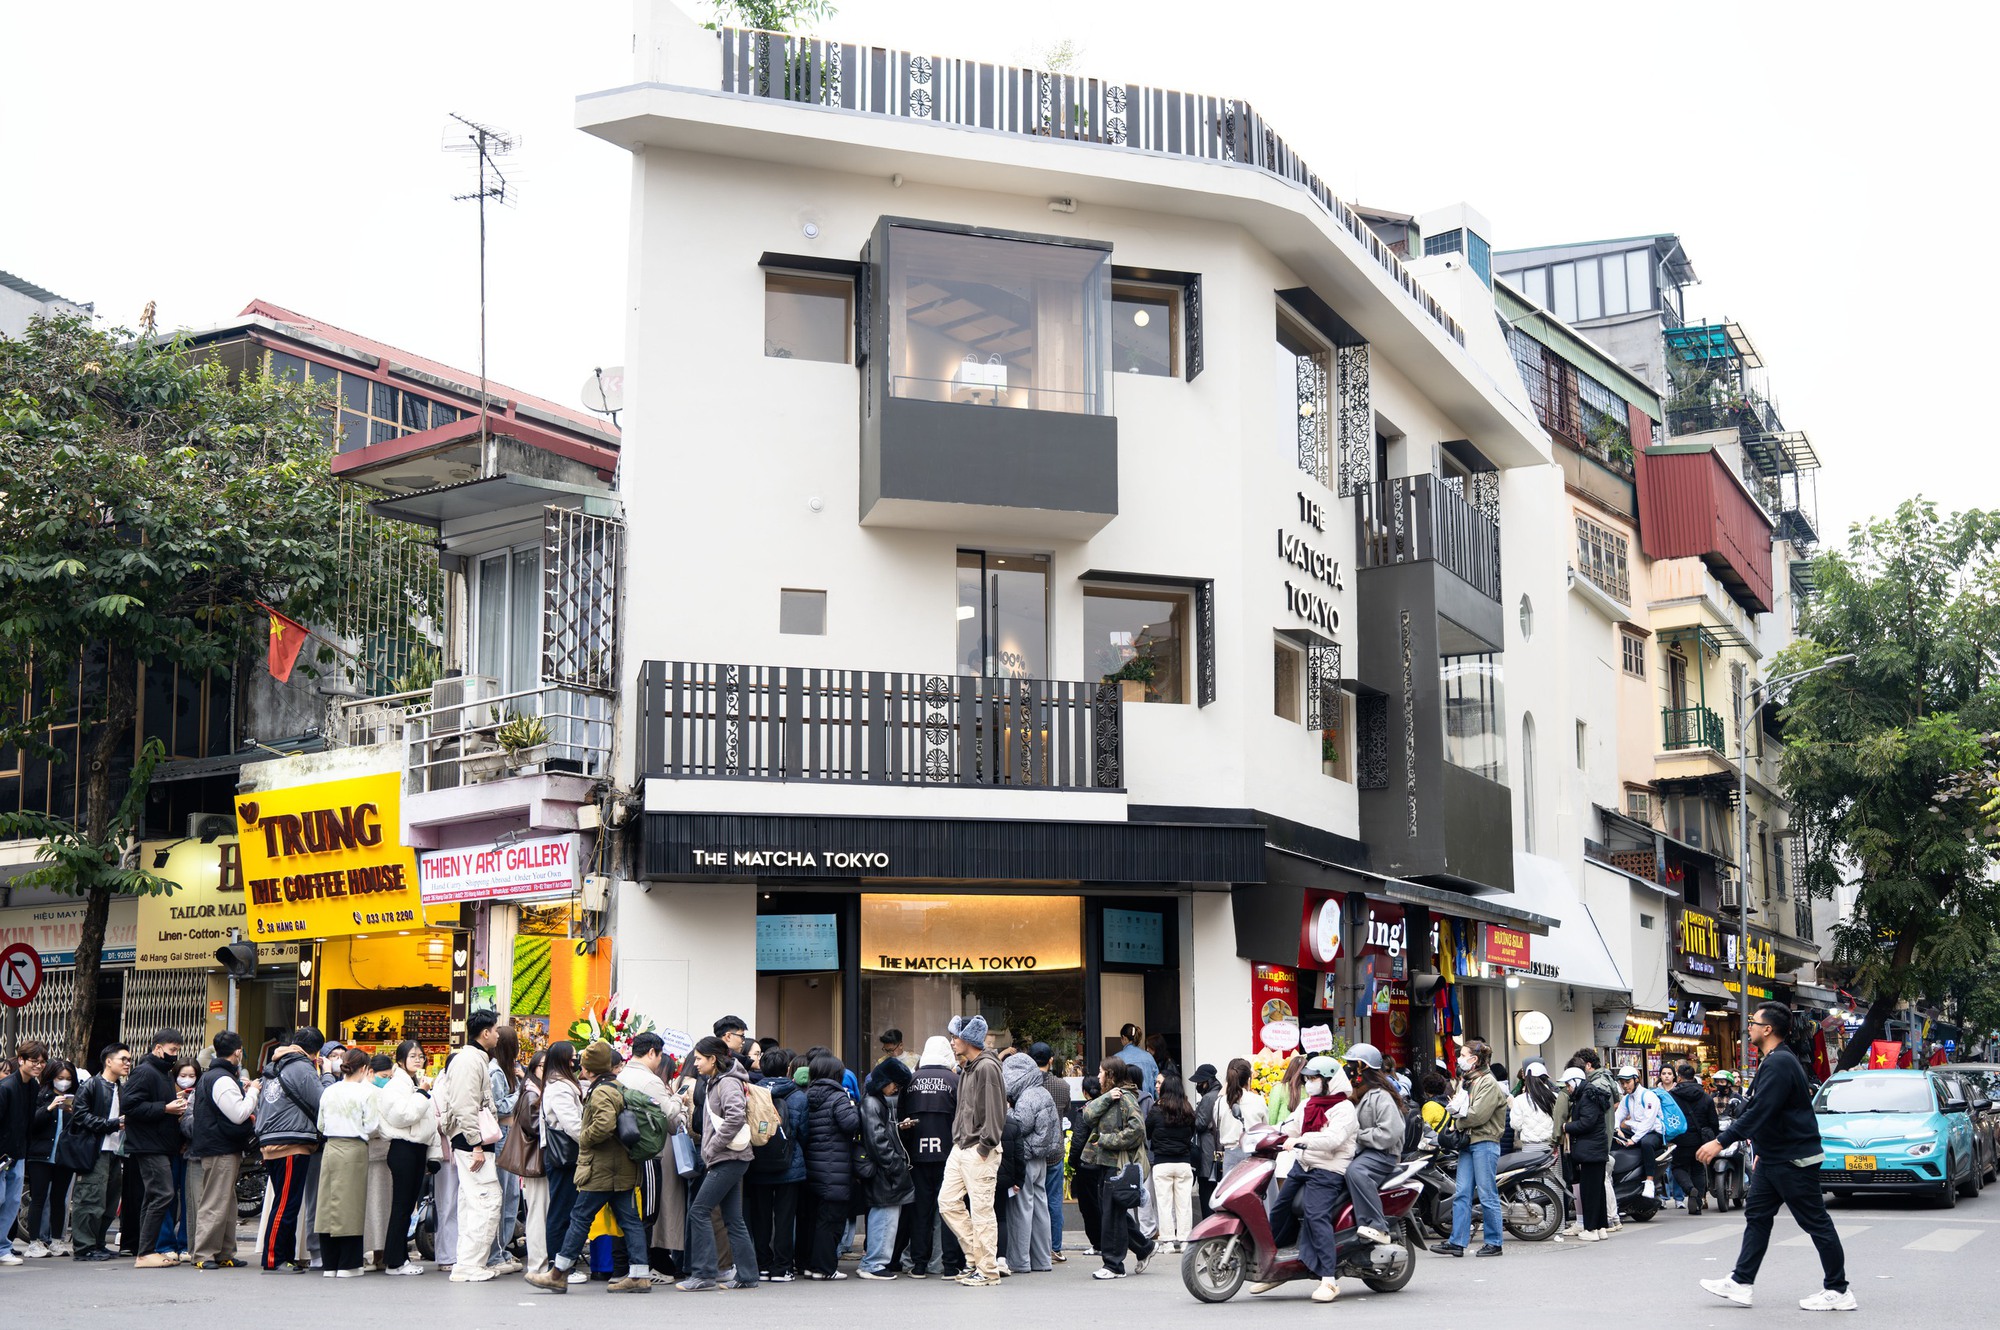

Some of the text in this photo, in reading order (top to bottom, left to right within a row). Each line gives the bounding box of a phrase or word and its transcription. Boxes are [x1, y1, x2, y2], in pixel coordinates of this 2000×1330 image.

[1297, 491, 1327, 532] THE
[1278, 528, 1345, 592] MATCHA
[1285, 580, 1341, 635] TOKYO
[258, 803, 383, 859] TRUNG
[422, 841, 570, 880] THIEN Y ART GALLERY
[693, 850, 890, 868] THE MATCHA TOKYO
[514, 873, 532, 882] Order
[532, 871, 548, 880] Your
[547, 870, 562, 879] Own
[248, 864, 407, 906] THE COFFEE HOUSE
[33, 911, 55, 921] HIỆU
[56, 910, 77, 919] MAY
[170, 905, 215, 920] TAILOR
[366, 909, 414, 925] 033 478 2290
[266, 922, 275, 933] 38
[295, 919, 307, 931] GAI
[158, 929, 183, 942] Linen
[188, 928, 220, 940] Cotton
[139, 953, 148, 963] 40
[149, 952, 167, 964] Hang
[170, 951, 182, 961] Gai
[182, 950, 207, 961] Street
[879, 955, 1037, 970] THE MATCHA TOKYO
[1258, 969, 1295, 983] KingRoti
[1633, 1023, 1655, 1045] ROTI
[917, 1077, 944, 1085] YOUTH
[919, 1137, 942, 1154] FR
